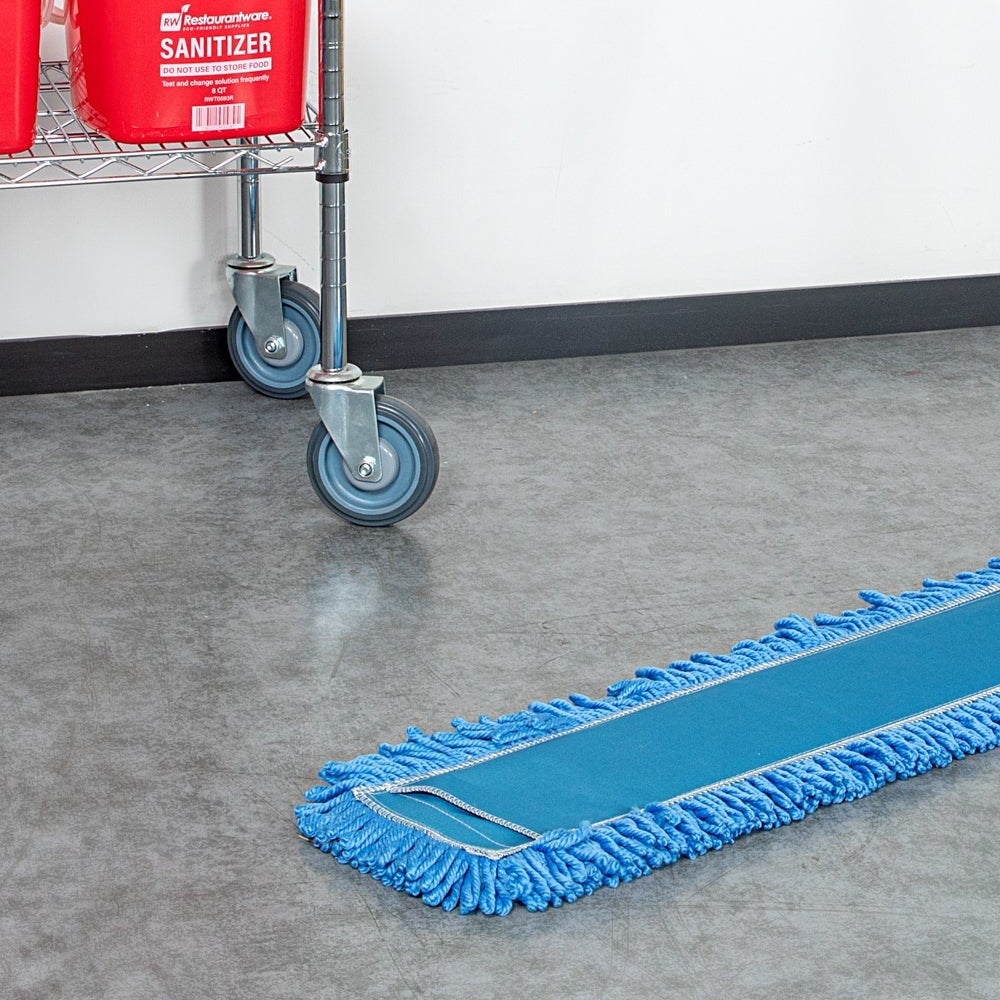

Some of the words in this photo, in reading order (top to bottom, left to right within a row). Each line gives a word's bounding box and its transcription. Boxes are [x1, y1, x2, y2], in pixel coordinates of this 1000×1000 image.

[163, 17, 180, 27] RW
[160, 32, 272, 59] SANITIZER
[176, 66, 192, 74] NOT
[195, 65, 210, 73] USE
[223, 63, 247, 72] STORE
[249, 60, 269, 69] FOOD
[176, 79, 189, 87] and
[190, 79, 213, 88] change
[215, 77, 239, 85] solution
[240, 74, 270, 84] frequently
